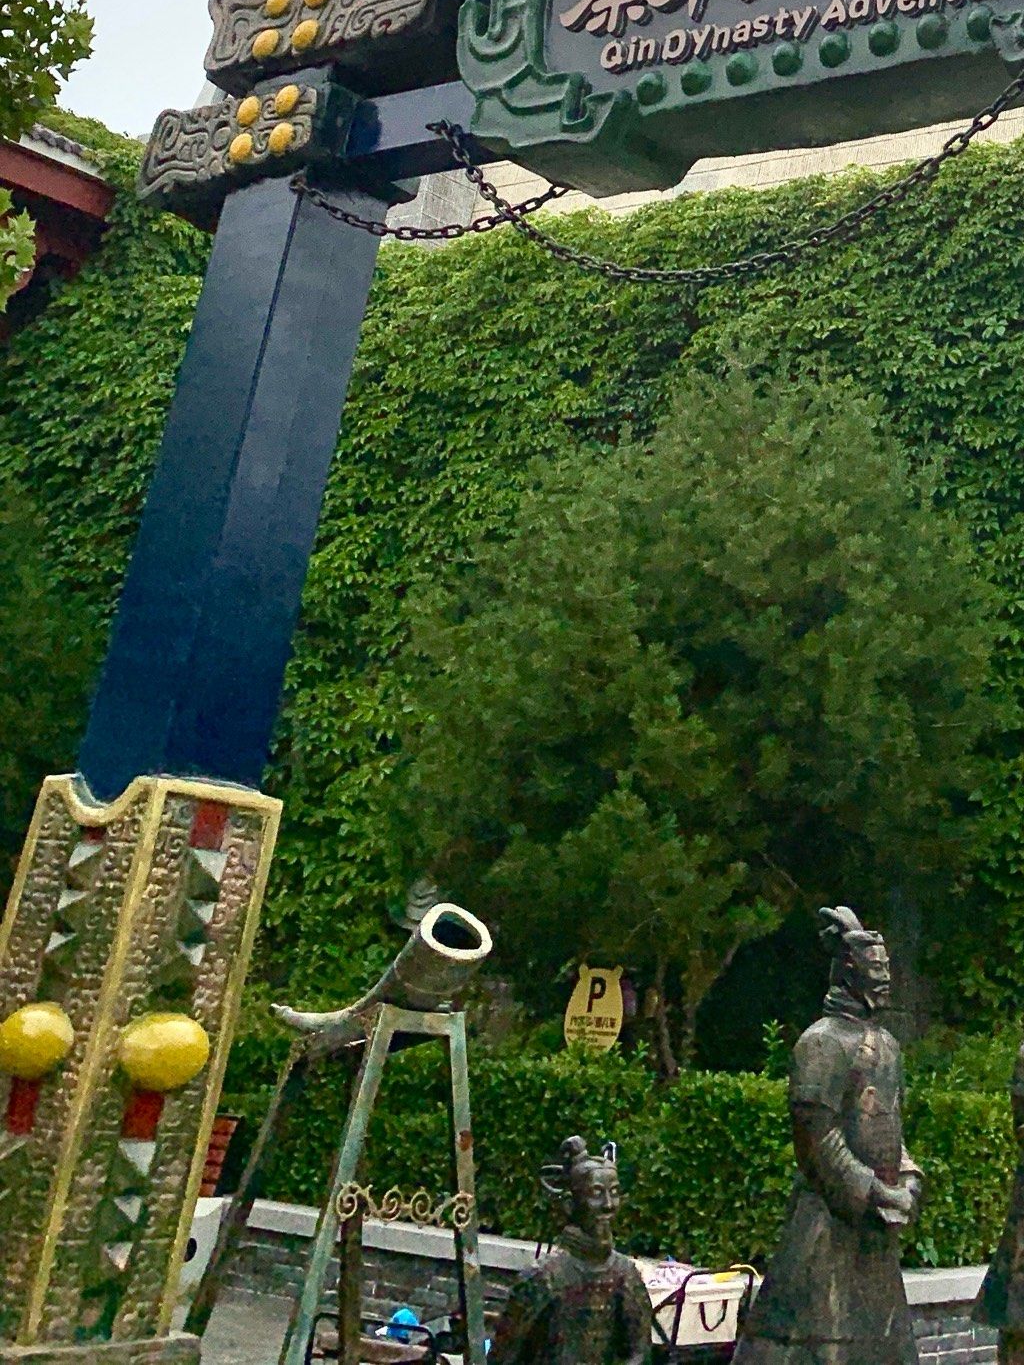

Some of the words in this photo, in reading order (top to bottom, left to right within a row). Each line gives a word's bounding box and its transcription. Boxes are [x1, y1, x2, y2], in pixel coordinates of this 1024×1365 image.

[600, 35, 657, 70] Qin
[661, 5, 818, 62] Dynasty
[586, 976, 607, 1013] P
